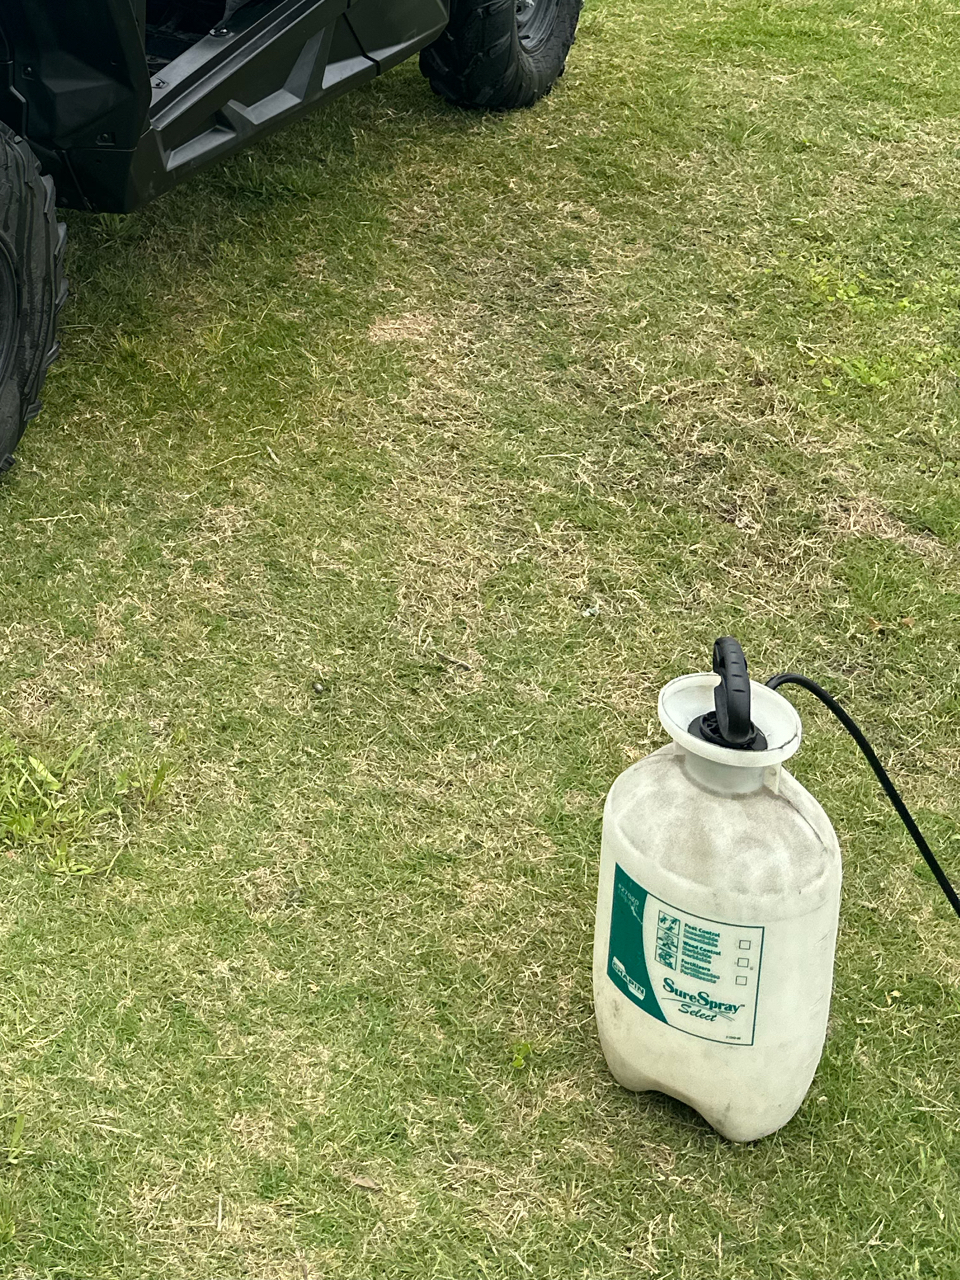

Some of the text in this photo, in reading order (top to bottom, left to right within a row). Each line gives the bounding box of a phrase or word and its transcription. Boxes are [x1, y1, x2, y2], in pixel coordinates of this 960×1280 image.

[698, 927, 721, 938] Control
[699, 946, 722, 956] Control
[613, 962, 645, 995] CHAPIN
[663, 977, 741, 1014] SureSpray
[678, 1003, 718, 1022] Select
